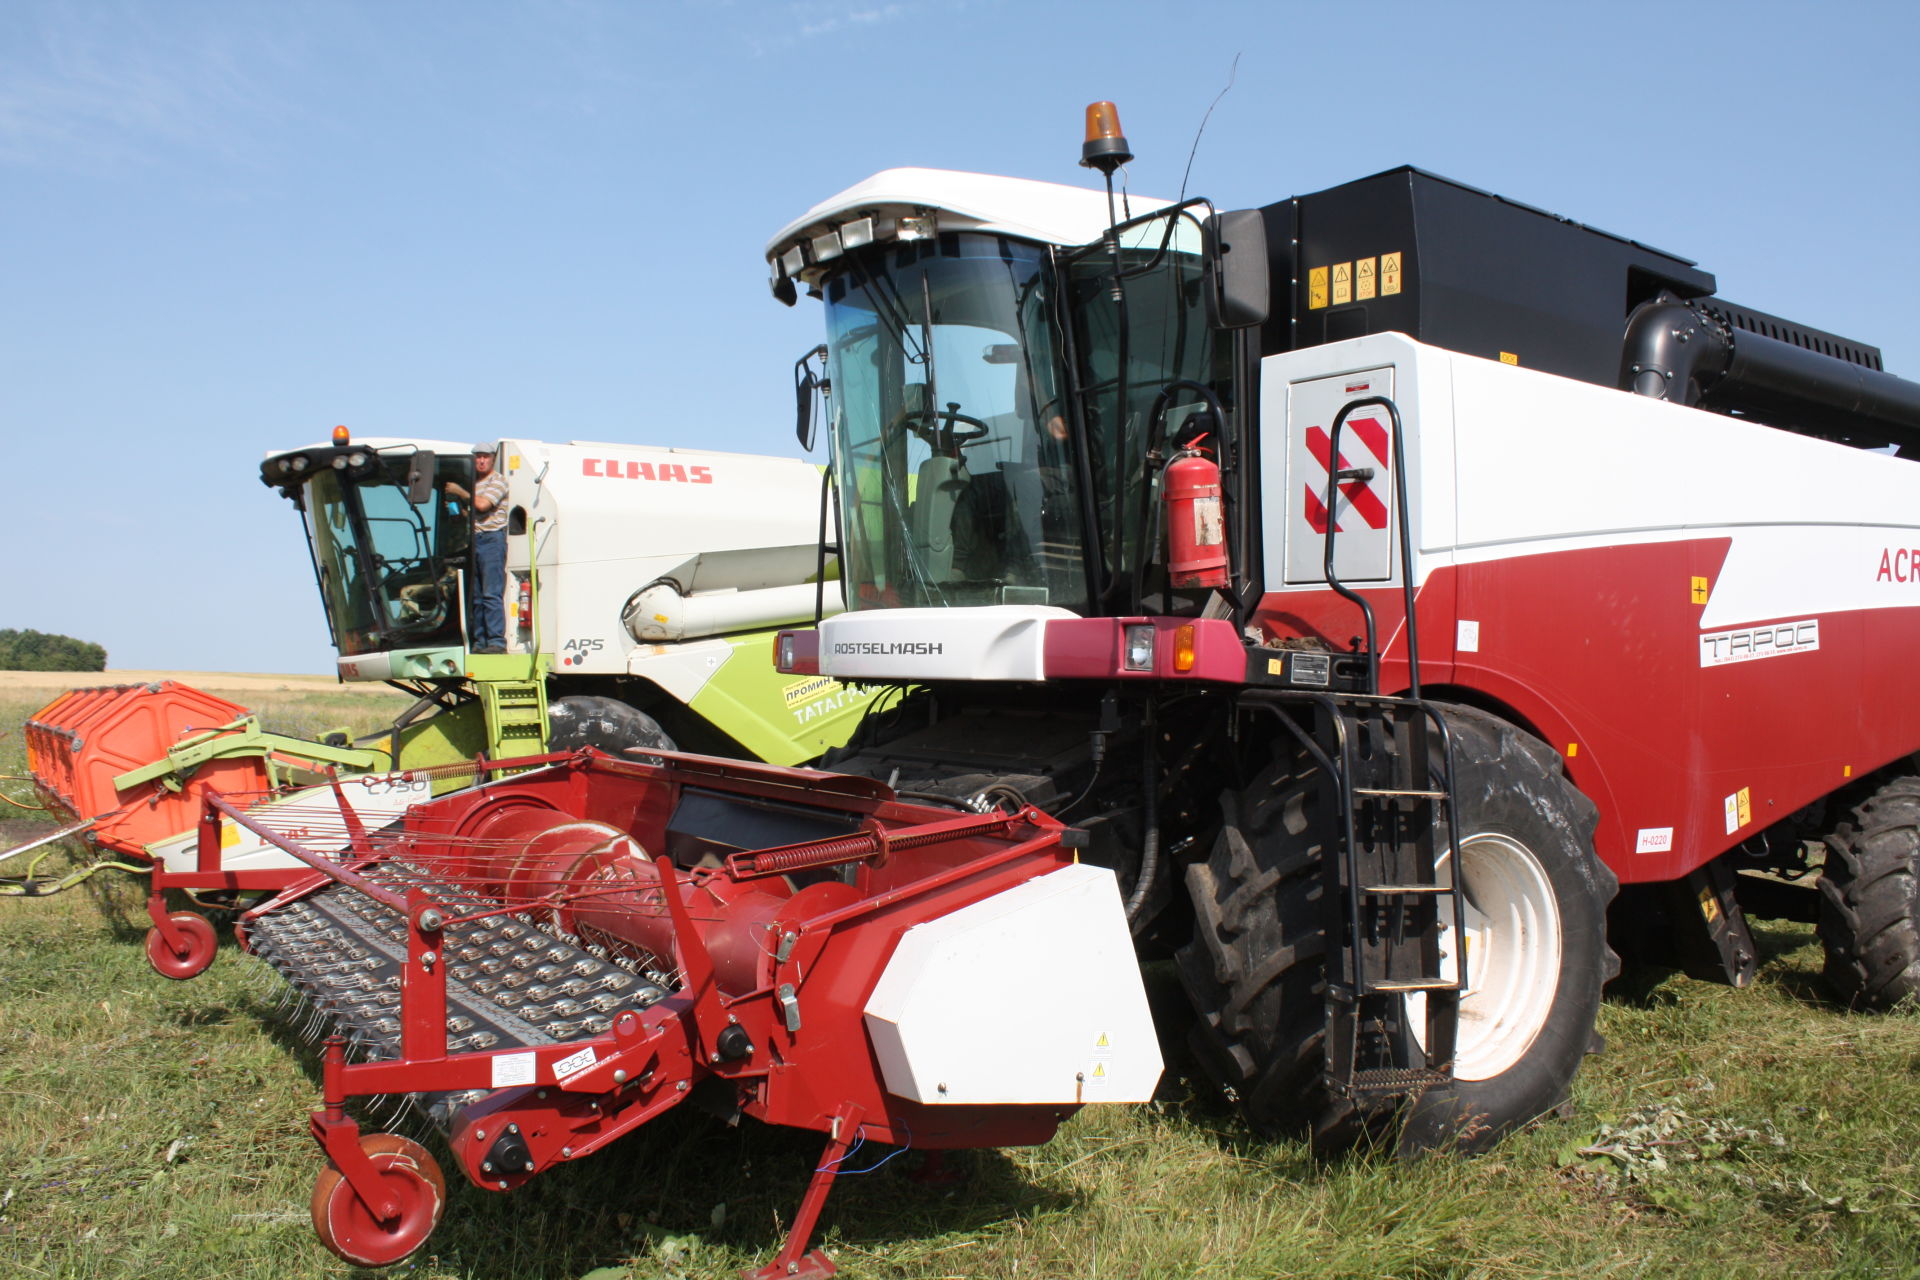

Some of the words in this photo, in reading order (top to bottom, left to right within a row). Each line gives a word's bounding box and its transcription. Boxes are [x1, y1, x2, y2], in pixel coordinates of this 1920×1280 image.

[583, 458, 713, 484] CLAAS
[563, 638, 605, 651] APS
[834, 642, 943, 655] ROSTSELMASH
